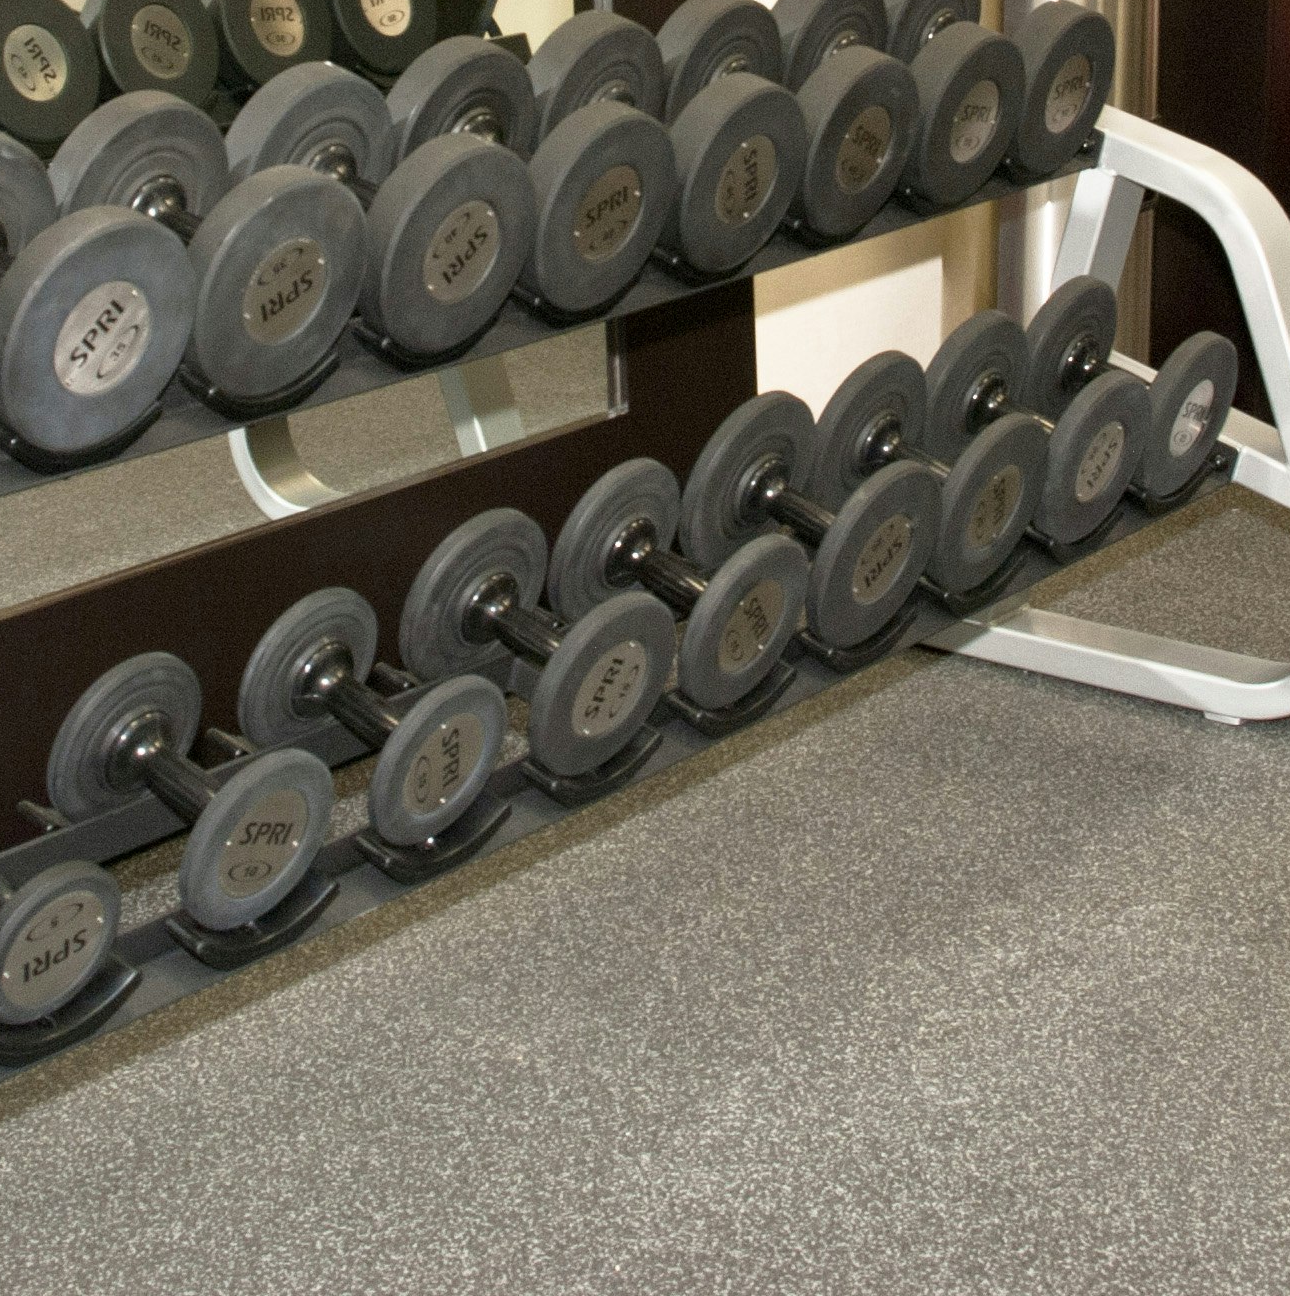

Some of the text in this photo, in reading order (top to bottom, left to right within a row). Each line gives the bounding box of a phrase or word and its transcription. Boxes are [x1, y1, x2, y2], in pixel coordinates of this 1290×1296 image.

[586, 184, 629, 227] SPRI
[442, 225, 488, 285] SPRI
[259, 270, 313, 322] SPRI
[69, 299, 125, 369] SPRI
[585, 657, 625, 720] SPRI
[441, 727, 460, 790] SPRI
[239, 821, 294, 847] SPRI
[22, 929, 89, 982] SPRI
